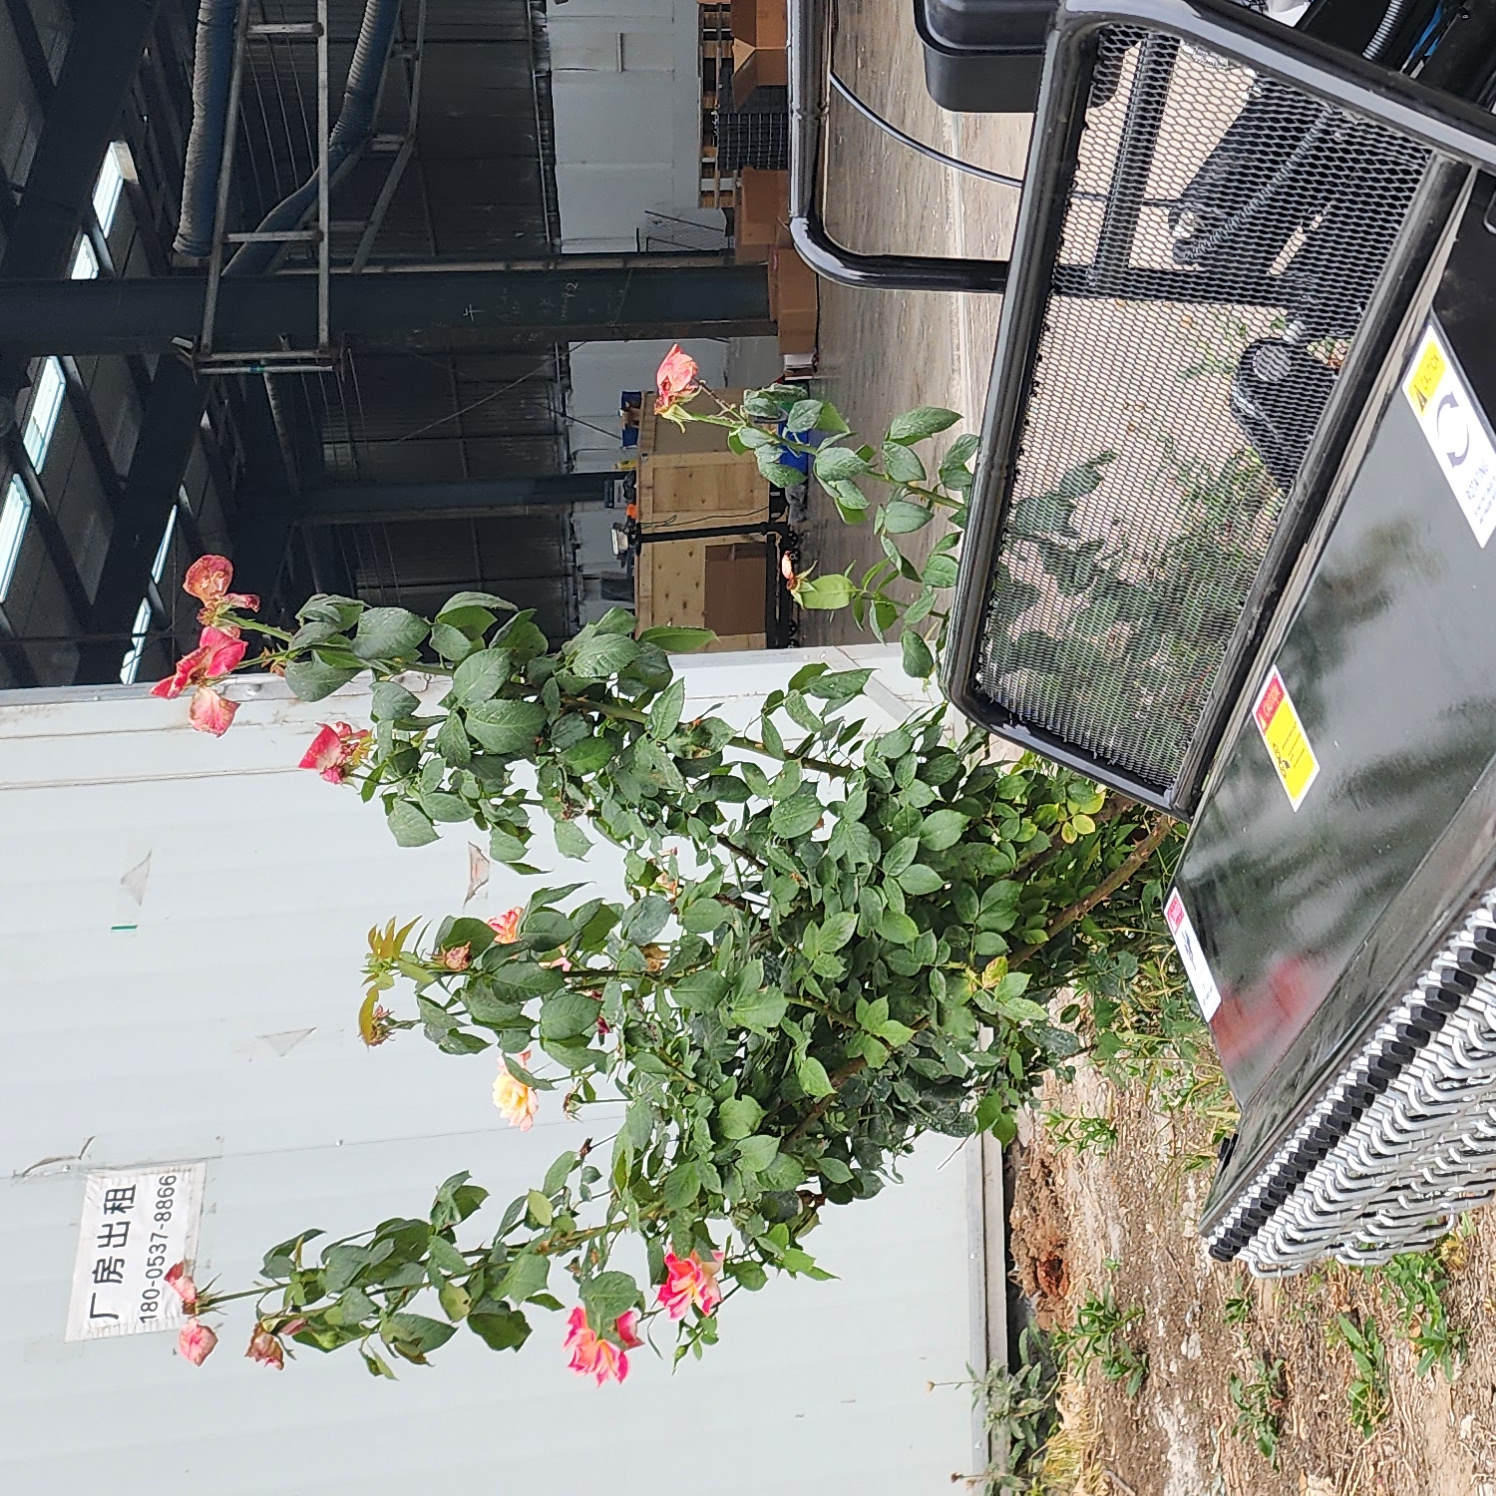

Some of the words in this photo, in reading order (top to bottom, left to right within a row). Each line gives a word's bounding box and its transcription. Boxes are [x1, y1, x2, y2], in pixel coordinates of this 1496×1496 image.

[89, 1184, 136, 1320] 厂房出租
[138, 1175, 177, 1324] 180-0537-8866
